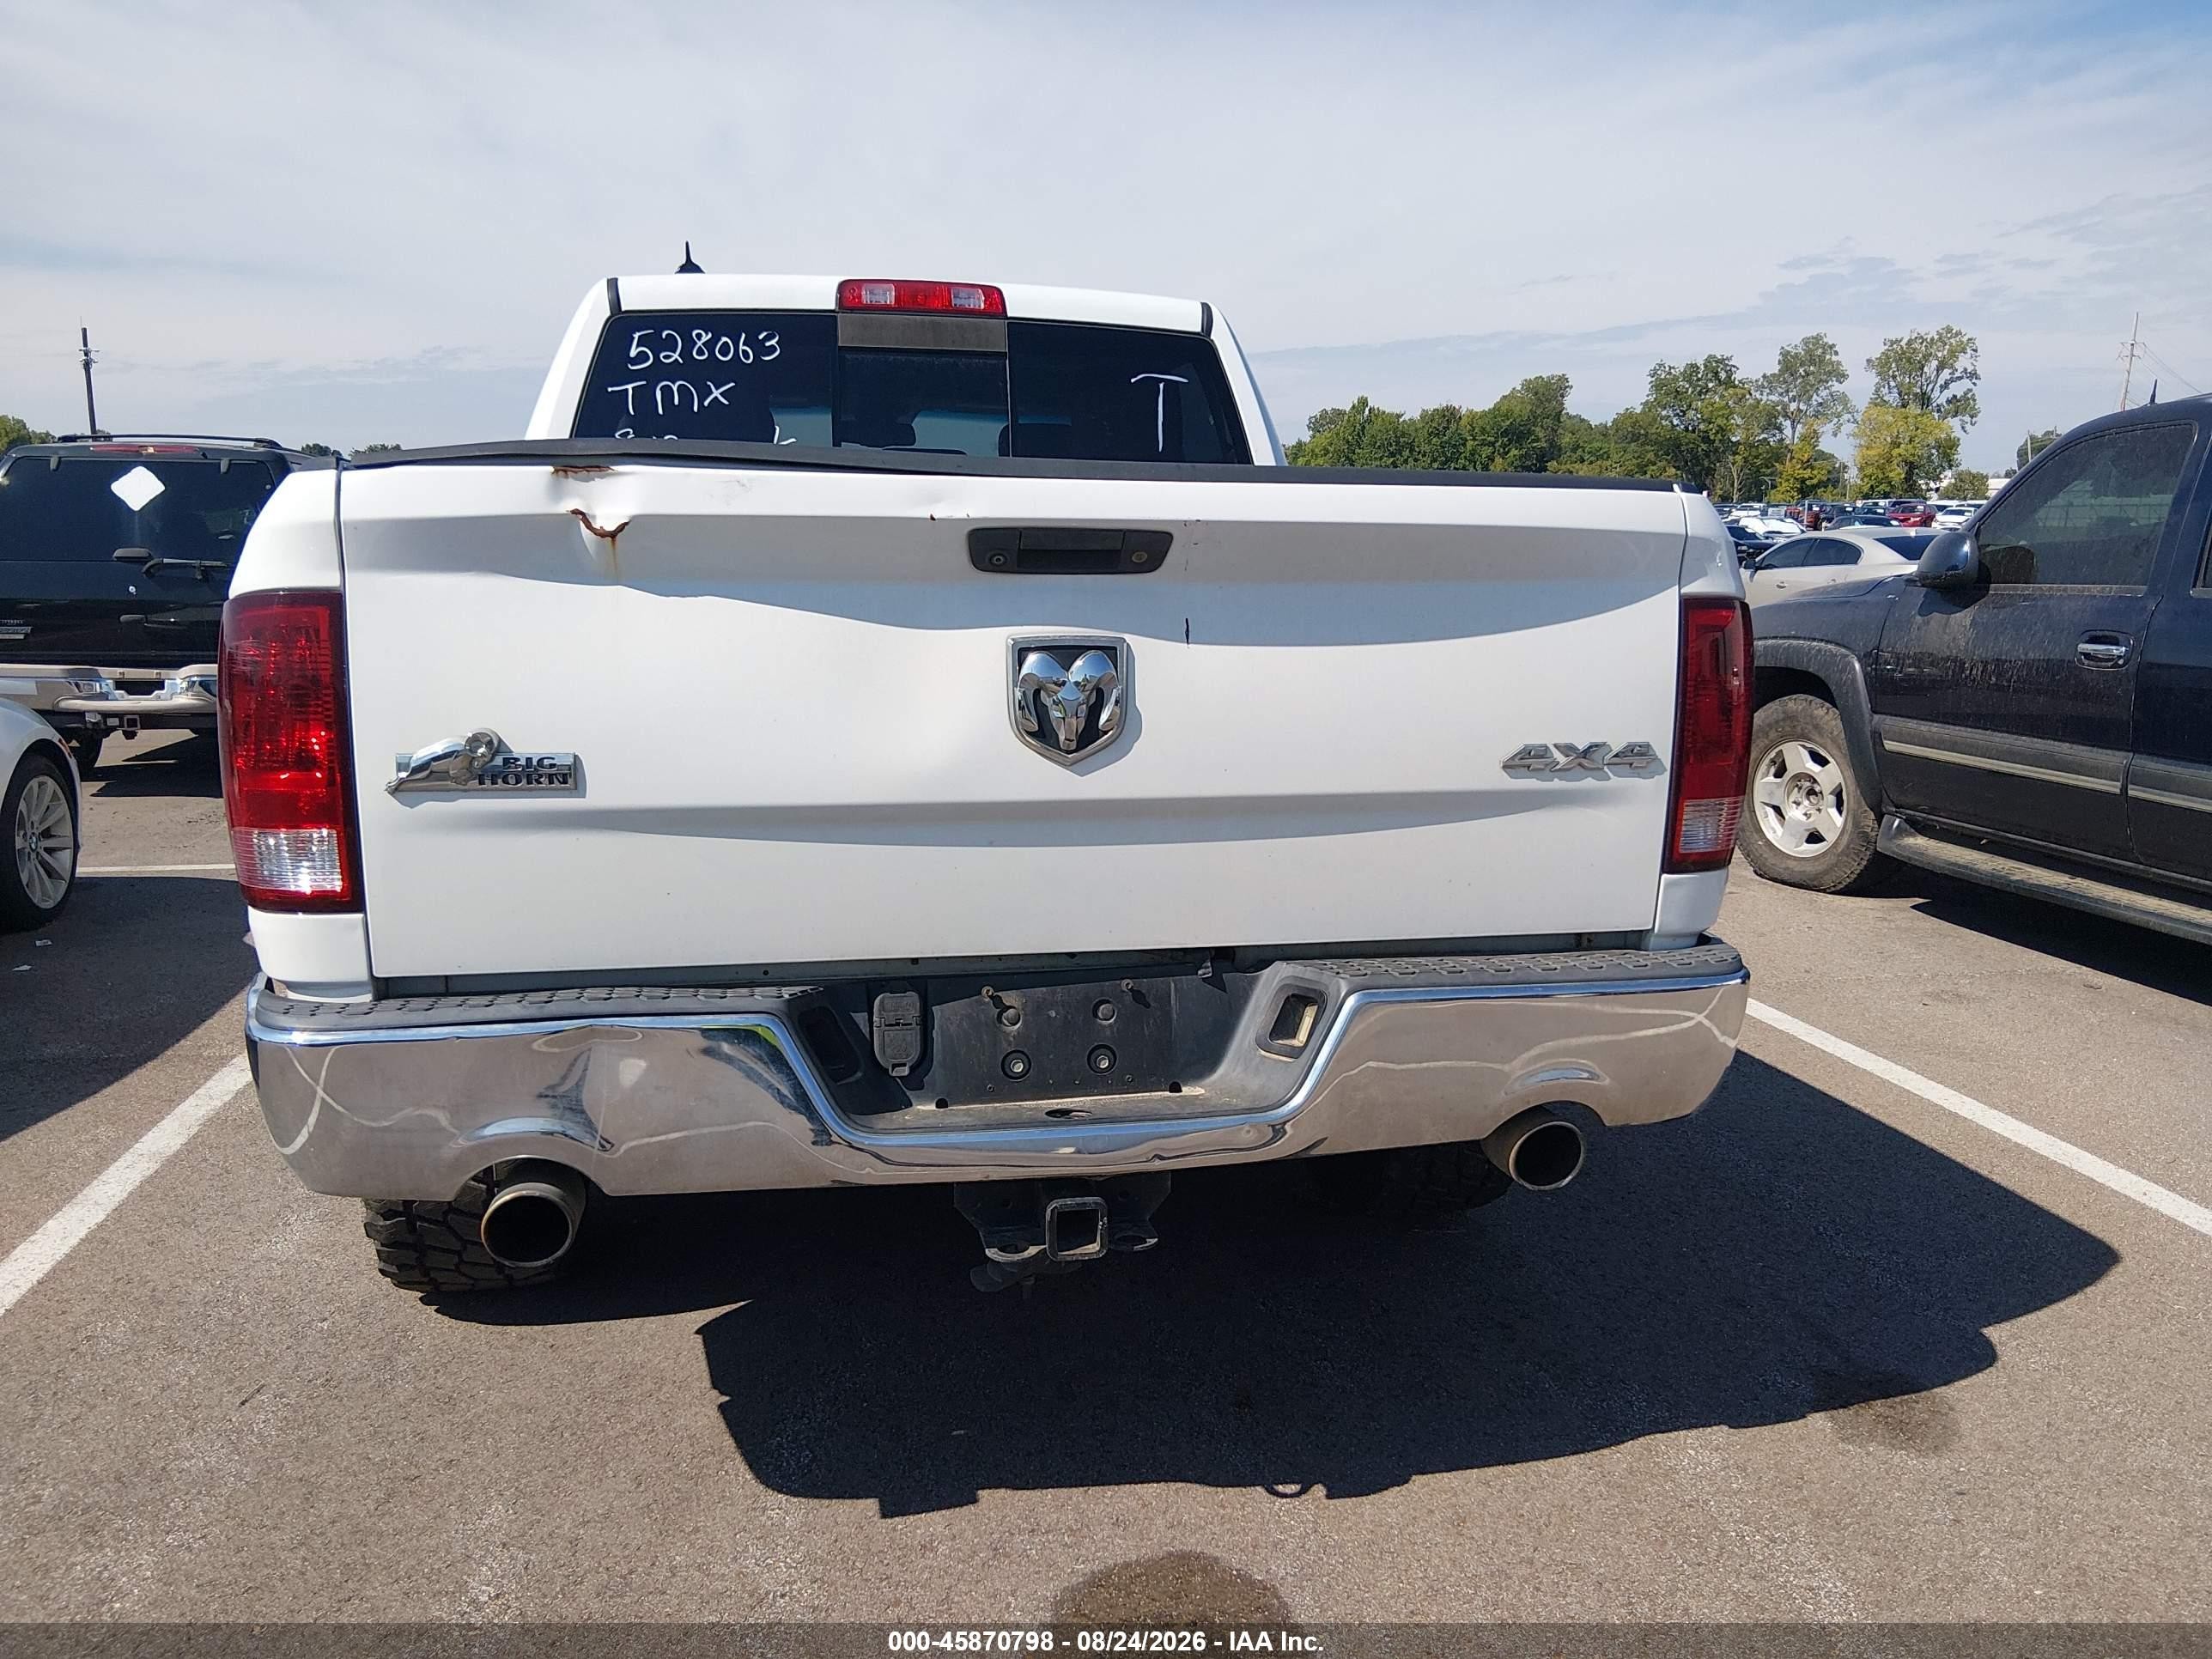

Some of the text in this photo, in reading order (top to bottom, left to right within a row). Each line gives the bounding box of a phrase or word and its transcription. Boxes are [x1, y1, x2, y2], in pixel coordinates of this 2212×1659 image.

[627, 329, 781, 370] 528063
[607, 380, 736, 416] TMX
[1130, 373, 1189, 453] T
[477, 773, 571, 787] HORN
[501, 757, 557, 772] BIG
